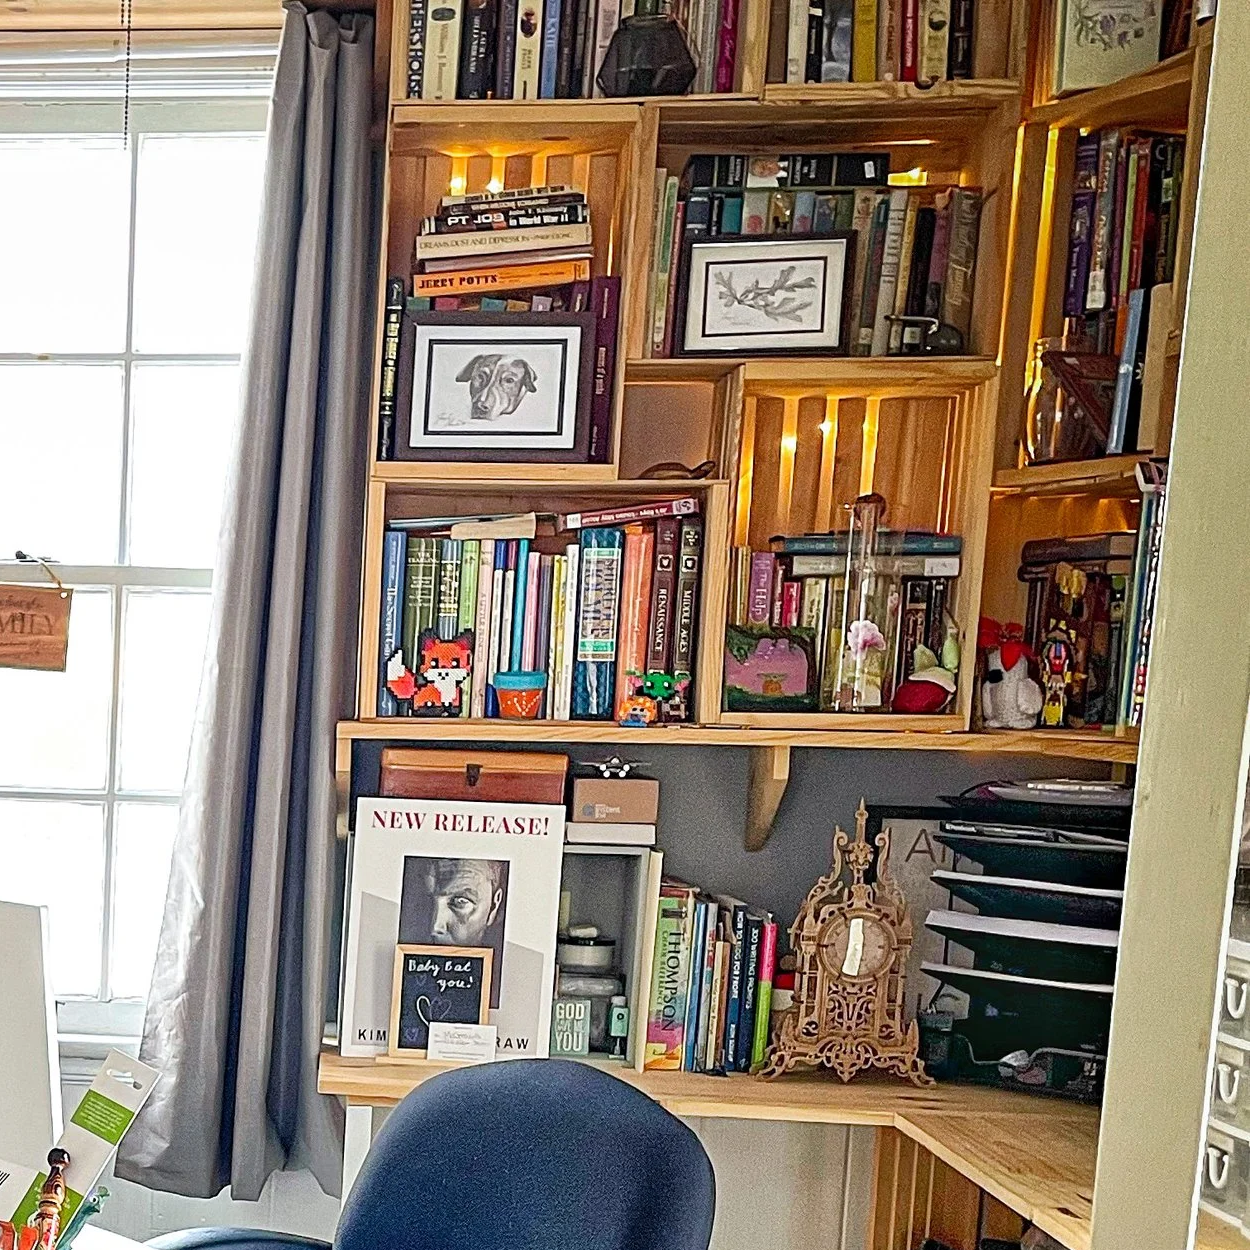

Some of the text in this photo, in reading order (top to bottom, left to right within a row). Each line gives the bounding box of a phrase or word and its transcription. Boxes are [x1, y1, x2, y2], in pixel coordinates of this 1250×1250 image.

[447, 214, 470, 226] PT
[518, 216, 541, 226] World
[542, 215, 559, 223] War
[419, 275, 498, 289] JERRY POTTS
[387, 587, 396, 604] The
[751, 572, 768, 616] The Help
[385, 605, 395, 637] Secret
[654, 588, 668, 652] RENAISSANCE
[680, 590, 693, 653] MIDDLE AGES
[371, 811, 550, 836] NEW RELEASE!
[736, 911, 744, 929] HOW
[660, 930, 669, 957] CHAIN
[736, 930, 744, 938] TO
[408, 959, 441, 976] Baby
[733, 961, 741, 974] FOR
[748, 944, 758, 976] WRITING
[436, 976, 474, 992] you!
[656, 961, 666, 1005] REFERENCE
[660, 931, 683, 1032] THOMPSON
[732, 976, 740, 999] PROFIT
[745, 977, 755, 1009] PROMPTS
[555, 1003, 585, 1020] GOD
[358, 1029, 386, 1041] KIM
[555, 1031, 583, 1052] YOU
